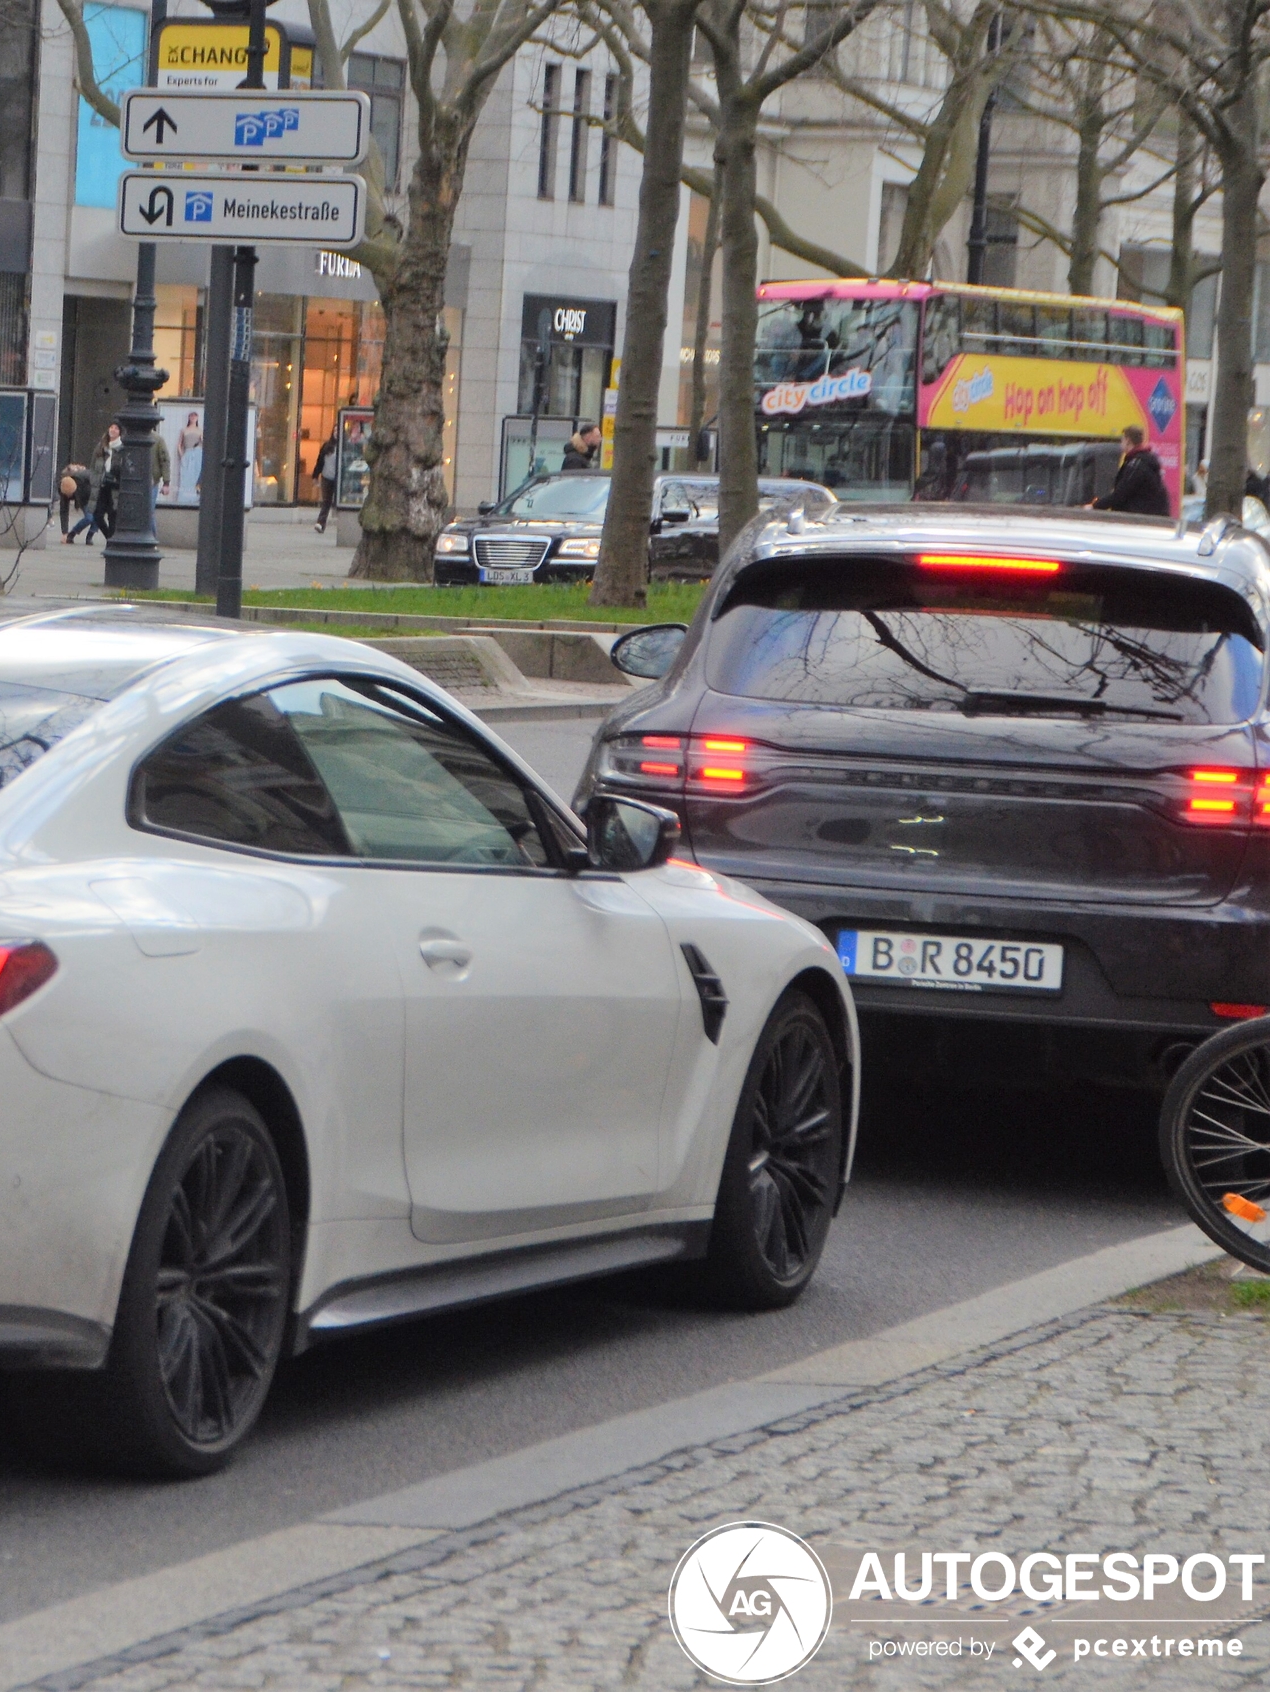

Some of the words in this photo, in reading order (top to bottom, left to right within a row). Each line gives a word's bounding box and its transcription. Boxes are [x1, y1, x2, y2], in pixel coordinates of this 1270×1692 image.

[168, 45, 248, 65] EXCHANG
[166, 75, 203, 88] Experts
[204, 75, 218, 86] for
[223, 198, 340, 222] Meinekestraße
[554, 308, 587, 333] CHRIST
[765, 385, 806, 409] city
[810, 370, 869, 400] circle
[1004, 382, 1033, 425] Hop
[1038, 385, 1054, 416] on
[1058, 378, 1084, 423] hop
[1088, 365, 1108, 416] off
[486, 570, 505, 581] LDS
[510, 572, 522, 582] XL
[524, 573, 529, 582] 3
[871, 937, 895, 971] B
[921, 940, 943, 975] R
[953, 942, 1045, 982] 8450
